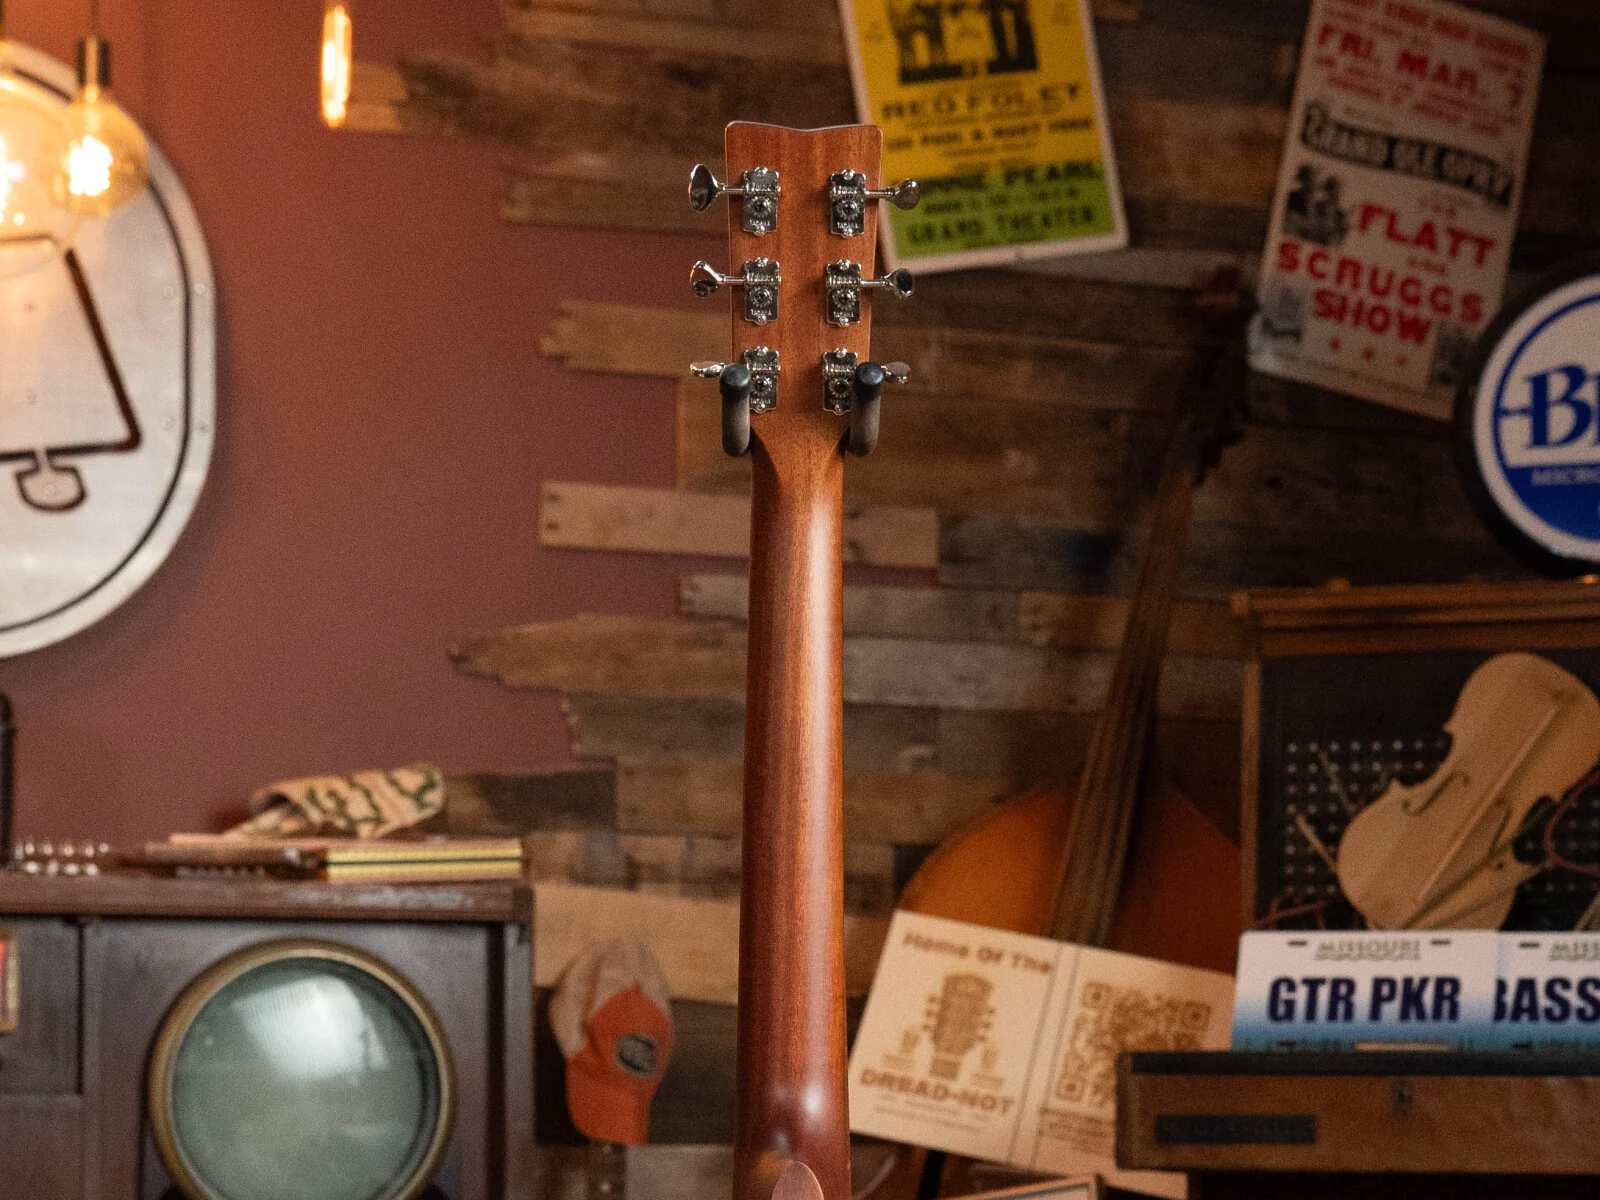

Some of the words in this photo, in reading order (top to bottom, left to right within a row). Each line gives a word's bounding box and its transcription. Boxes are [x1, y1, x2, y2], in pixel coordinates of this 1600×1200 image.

[966, 82, 1081, 110] FOLEY
[1003, 161, 1104, 187] PEARL
[1358, 203, 1496, 267] FLATT
[1277, 241, 1484, 324] SCRUGGS
[1313, 288, 1432, 345] SHOW
[1524, 362, 1600, 449] B
[903, 932, 969, 961] Home
[1316, 940, 1423, 961] MISSOURI
[1267, 975, 1356, 1024] GTR
[1369, 975, 1462, 1024] PKR
[858, 1066, 1021, 1114] DREAD-NOT
